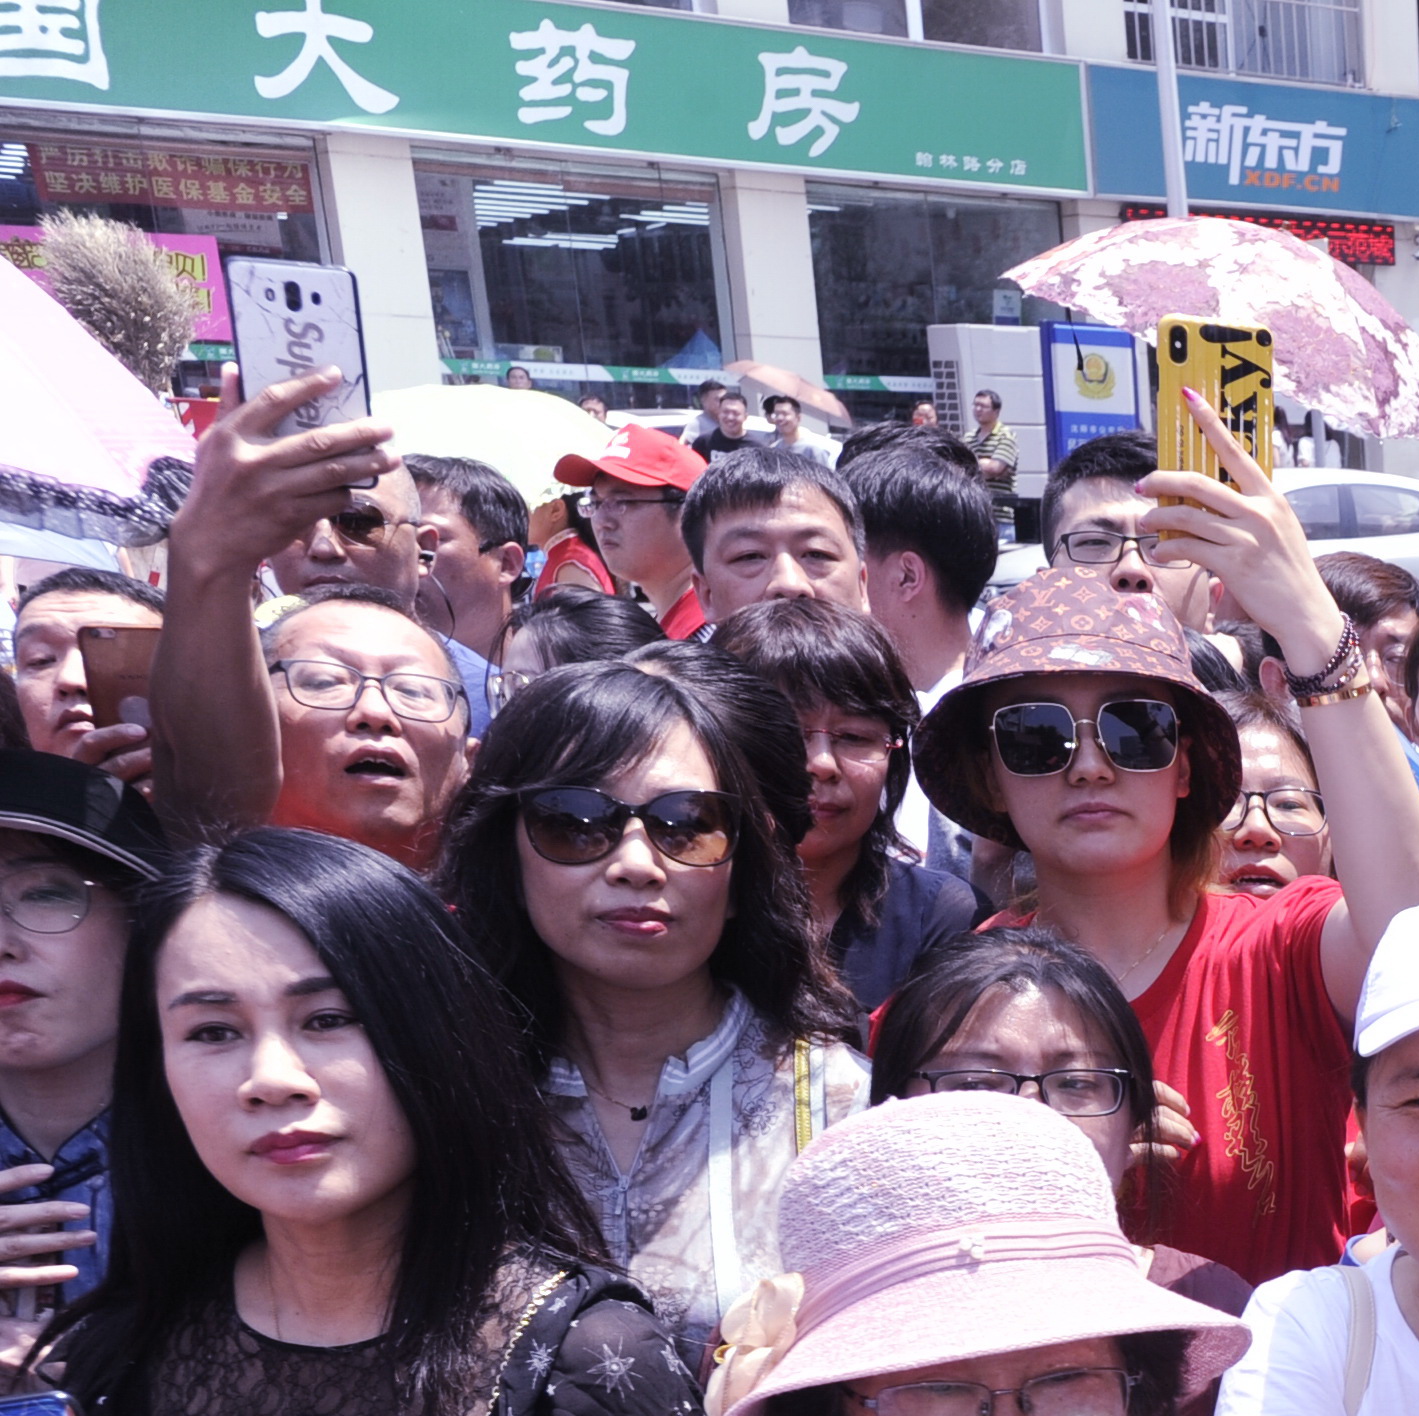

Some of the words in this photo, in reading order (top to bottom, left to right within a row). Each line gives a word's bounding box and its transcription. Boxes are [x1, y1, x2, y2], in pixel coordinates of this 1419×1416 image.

[1184, 101, 1348, 186] 新东方
[40, 146, 304, 179] 严厉打击欺诈骗保行为
[915, 151, 1027, 176] 翰林路分店
[44, 171, 309, 206] 坚决维护医保基金安全
[1244, 169, 1340, 193] XDF.CN
[276, 317, 324, 429] Supe
